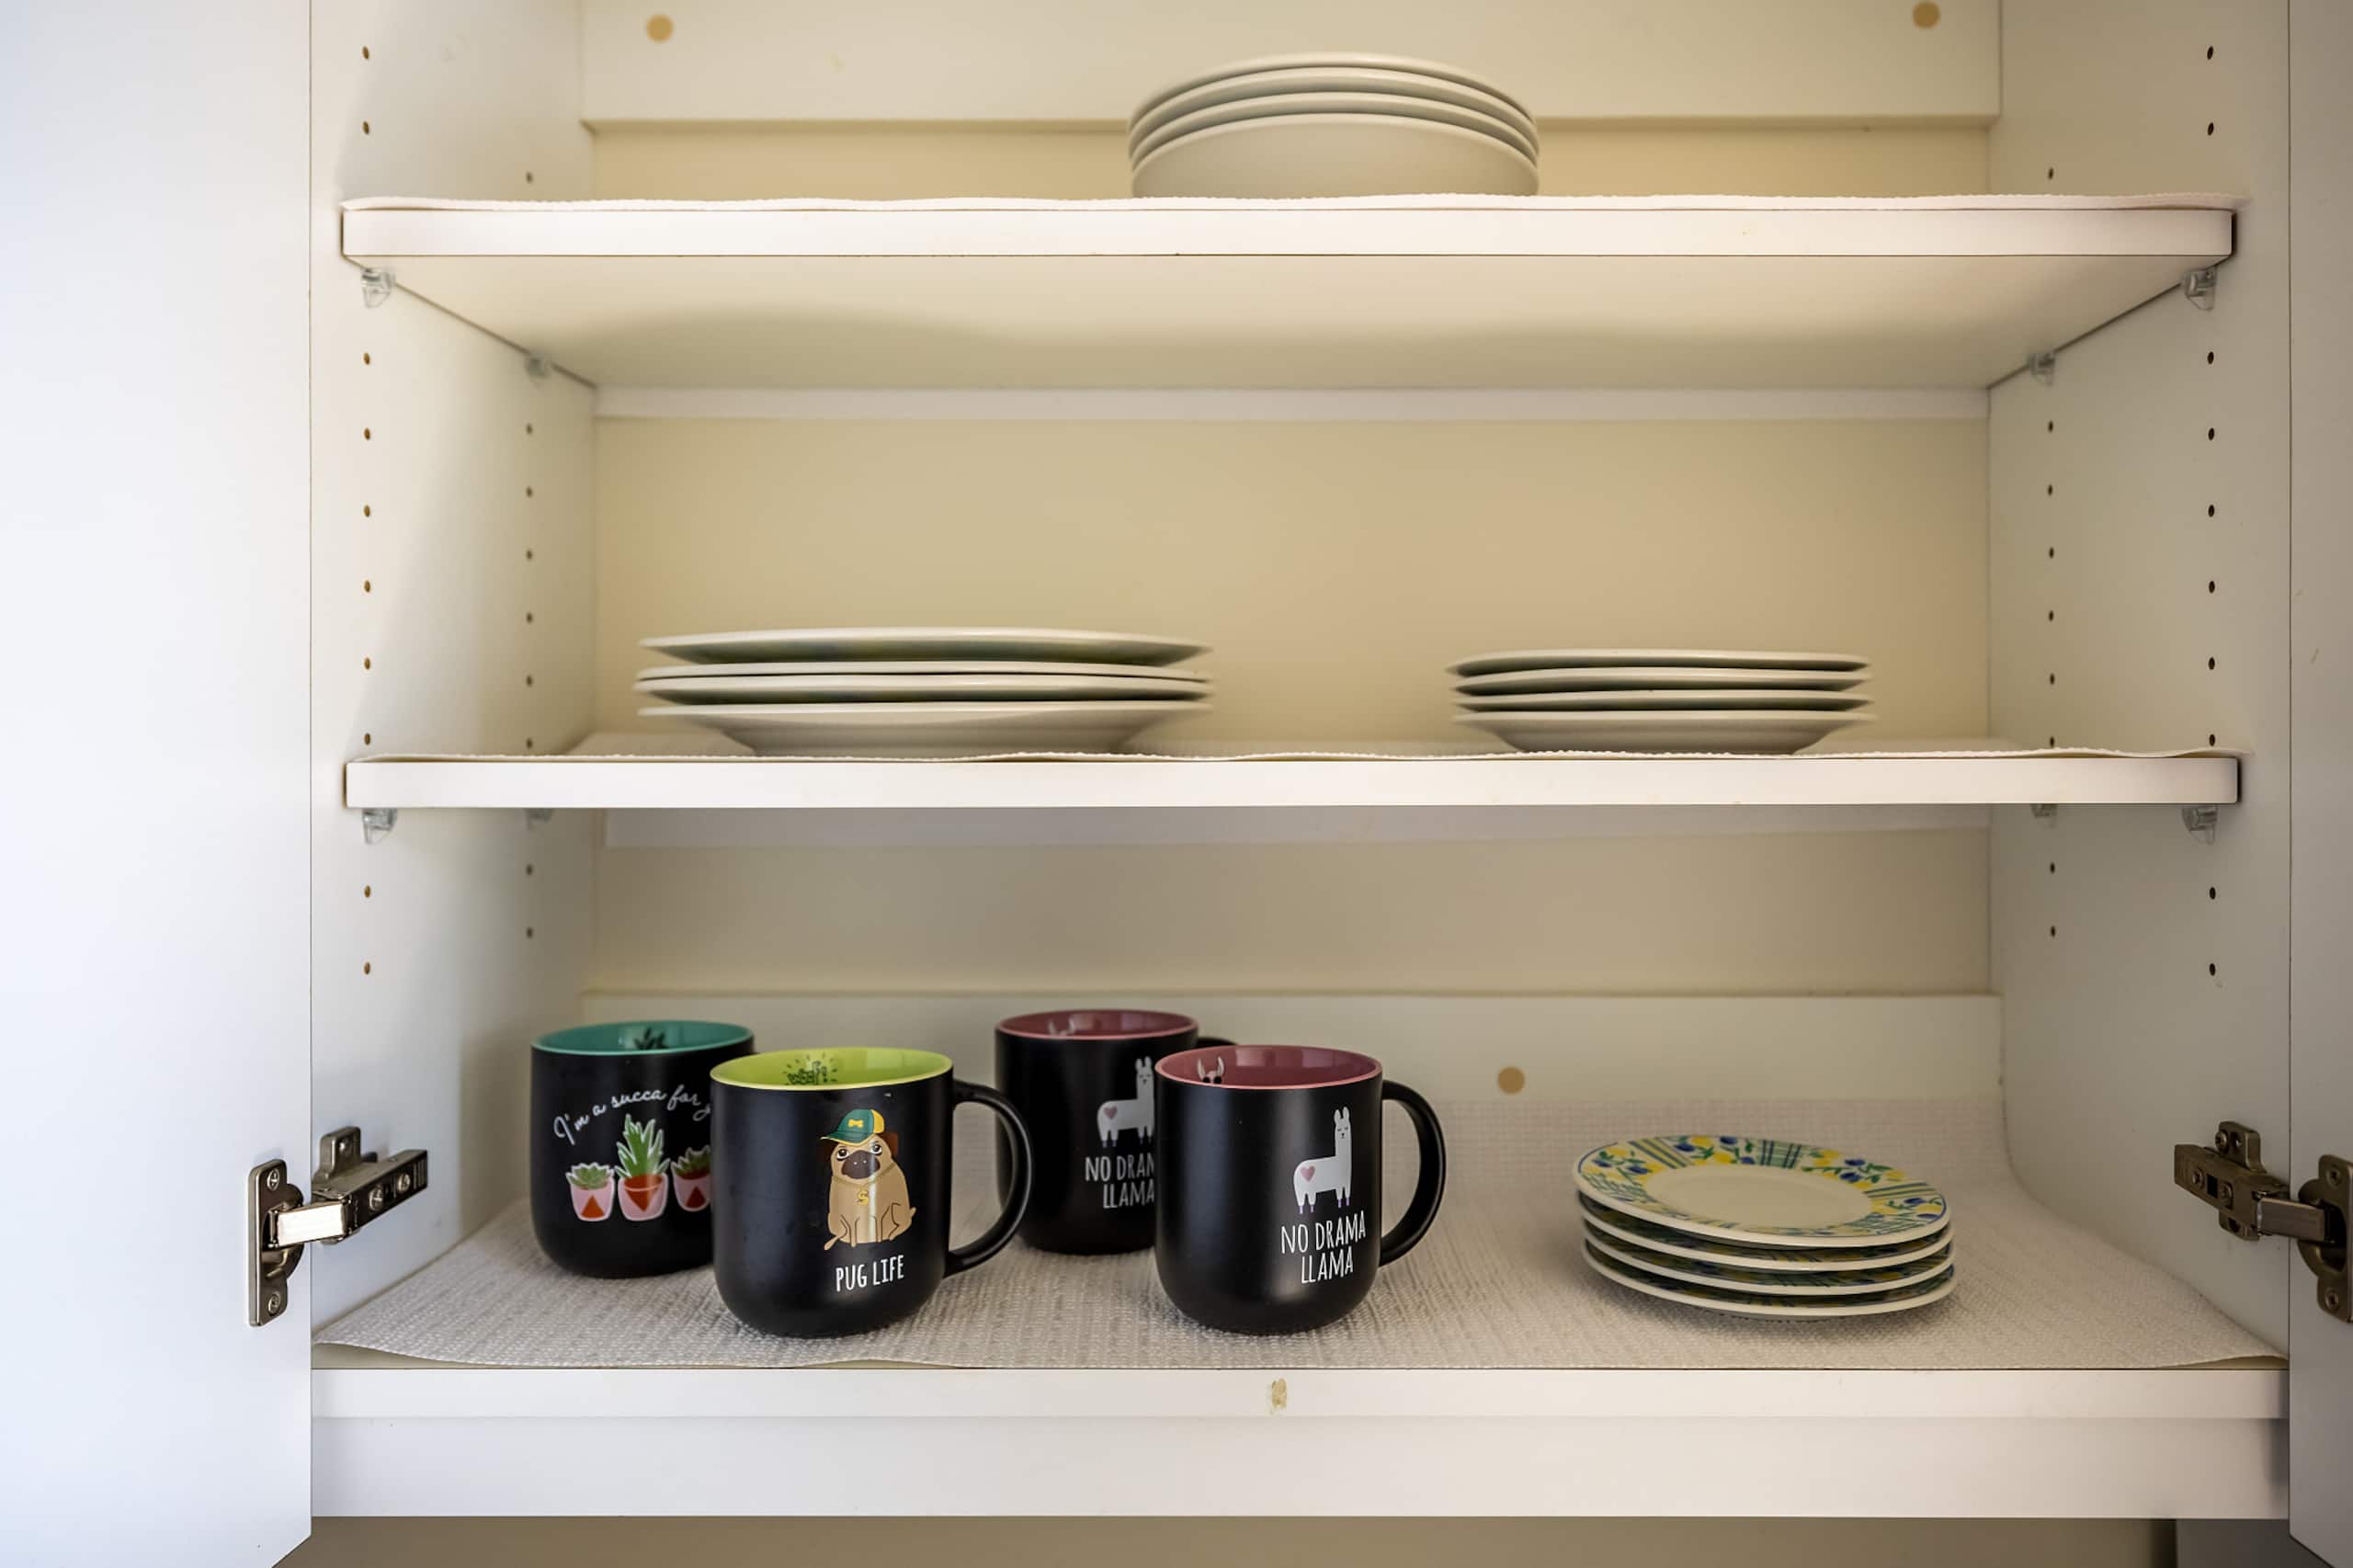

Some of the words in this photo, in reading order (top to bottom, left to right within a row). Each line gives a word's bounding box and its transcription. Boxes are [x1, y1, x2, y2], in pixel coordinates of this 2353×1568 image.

[553, 1112, 589, 1145] I'm
[592, 1104, 607, 1117] a
[610, 1089, 667, 1108] succa
[666, 1084, 700, 1111] for
[1085, 1155, 1111, 1182] NO
[1103, 1177, 1155, 1209] LLAMA
[1280, 1223, 1309, 1255] NO
[1314, 1210, 1367, 1251] DRAMA
[835, 1264, 868, 1292] PUG
[872, 1254, 904, 1286] LIFE
[1301, 1245, 1354, 1284] LLAMA
